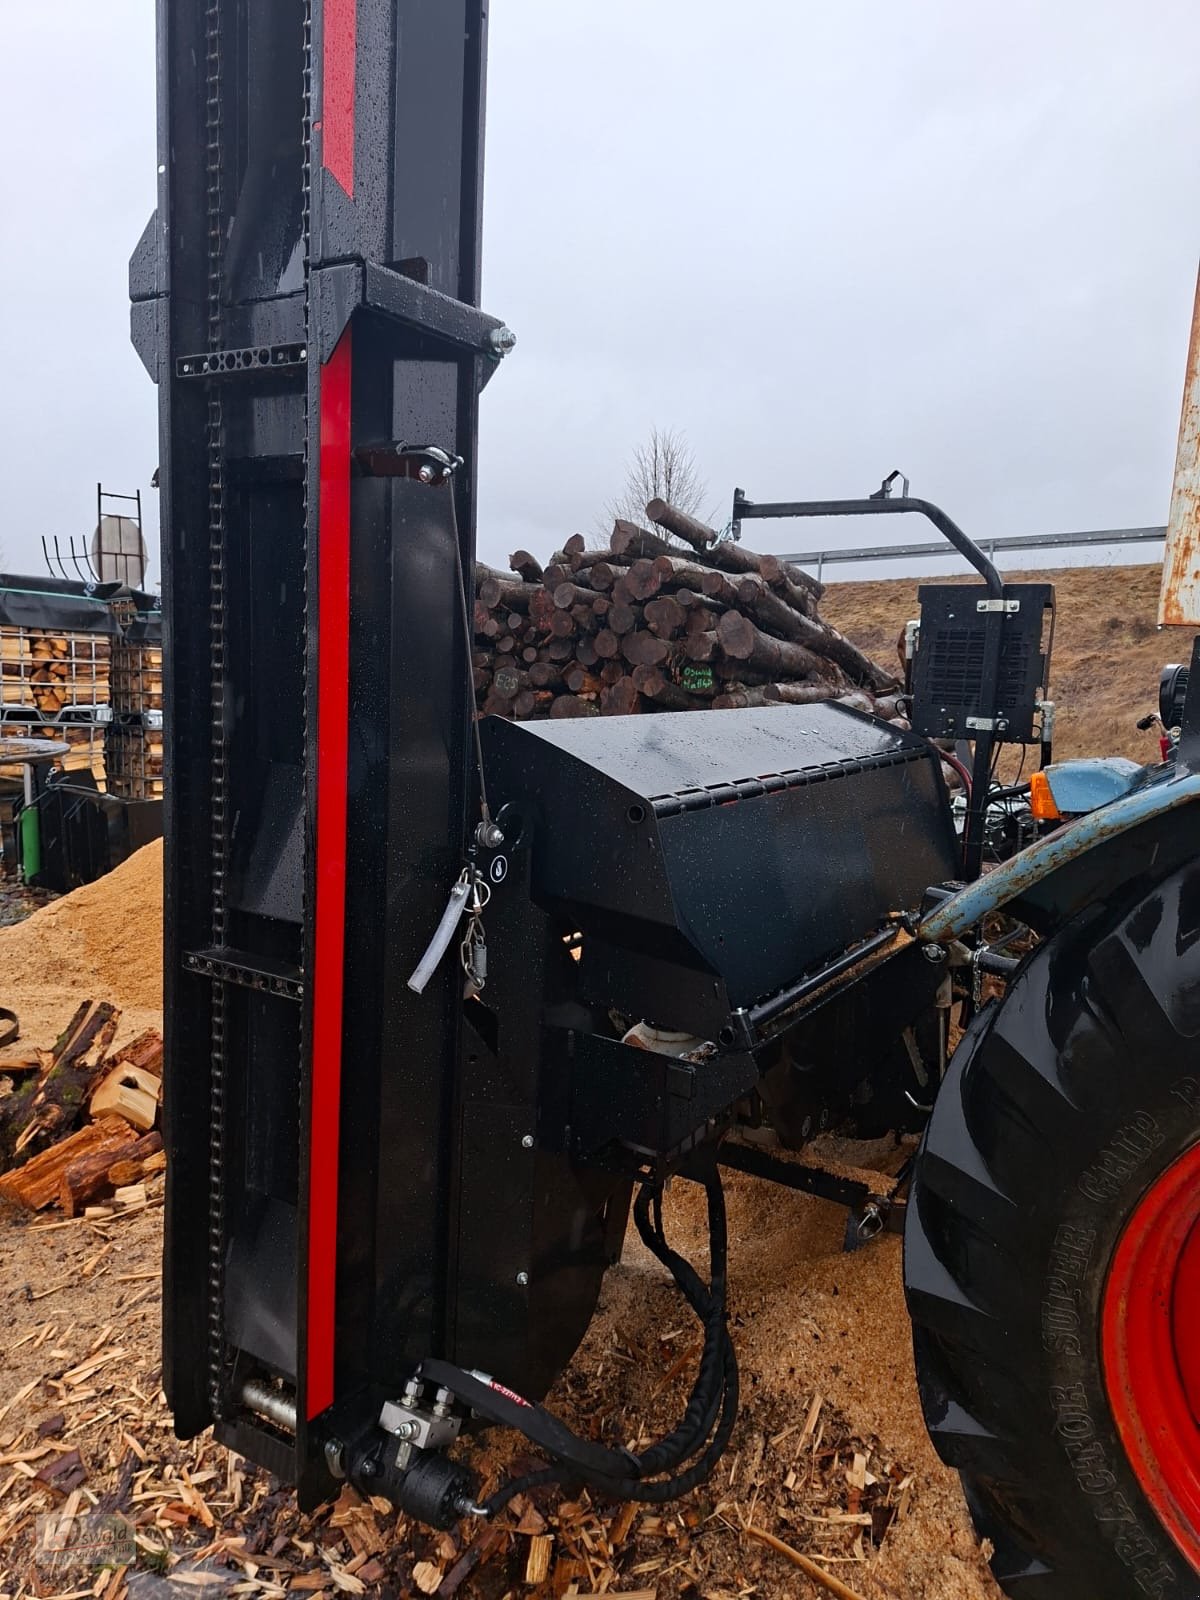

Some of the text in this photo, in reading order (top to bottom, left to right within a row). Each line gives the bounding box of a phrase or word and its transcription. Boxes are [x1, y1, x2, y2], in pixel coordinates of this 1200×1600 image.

[1040, 1110, 1176, 1600] TRACTOR SUPER GRIP
